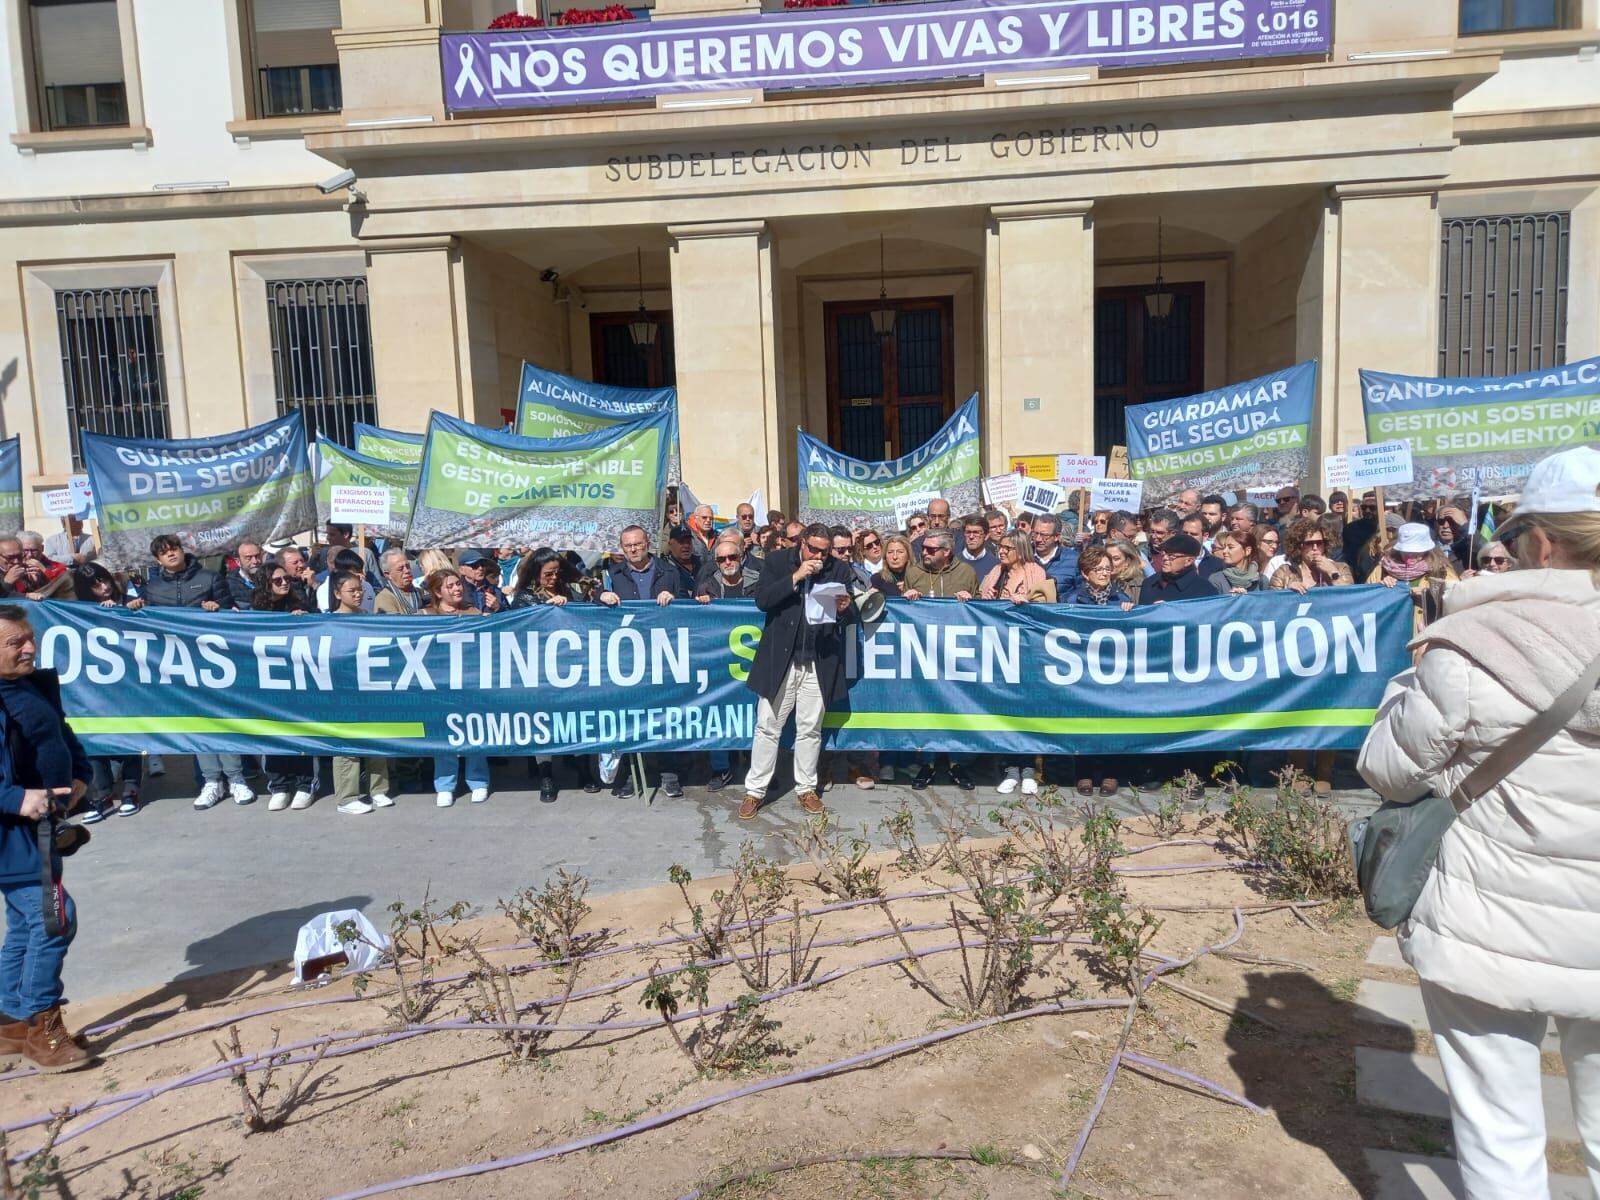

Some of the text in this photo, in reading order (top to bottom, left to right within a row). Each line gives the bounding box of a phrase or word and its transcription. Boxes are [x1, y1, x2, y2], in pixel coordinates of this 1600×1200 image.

[1272, 10, 1318, 31] 016
[490, 0, 1245, 89] NOS QUEREMOS VIVAS Y LIBRES
[1258, 33, 1286, 41] ATENCIÓN
[1292, 30, 1318, 38] VÍCTIMAS
[605, 123, 1159, 182] SUBDELEGACION DEL GOBIERNO
[1143, 380, 1288, 429] GUARDAMAR
[1148, 407, 1281, 452] DEL SEGURA
[1378, 409, 1479, 433] GESTIÓN
[115, 425, 291, 467] GUARDAMAR
[1435, 424, 1575, 450] SEDIMENTO
[456, 441, 481, 459] ES
[1077, 457, 1098, 466] AÑOS
[1355, 445, 1402, 456] ALBUFERETA
[1363, 456, 1395, 466] TOTALLY
[128, 454, 291, 496] DEL SEGURA
[1135, 450, 1215, 476] SALVEMOS
[1355, 464, 1406, 477] NEGLECTED!!!
[350, 473, 372, 486] NO
[441, 462, 529, 489] GESTIÓN
[892, 474, 922, 494] LAS
[107, 508, 140, 526] NO
[146, 499, 223, 521] ACTUAR
[227, 494, 245, 510] ES
[334, 498, 384, 506] REPARACIONES
[464, 490, 492, 508] DE
[865, 494, 898, 509] VID
[33, 624, 237, 690] OSTAS
[252, 635, 334, 691] EN
[356, 614, 709, 693] EXTINCIÓN,
[845, 622, 1021, 684] IENEN
[1043, 602, 1377, 686] SOLUCIÓN
[446, 703, 753, 746] SOMOSMEDITERRANI
